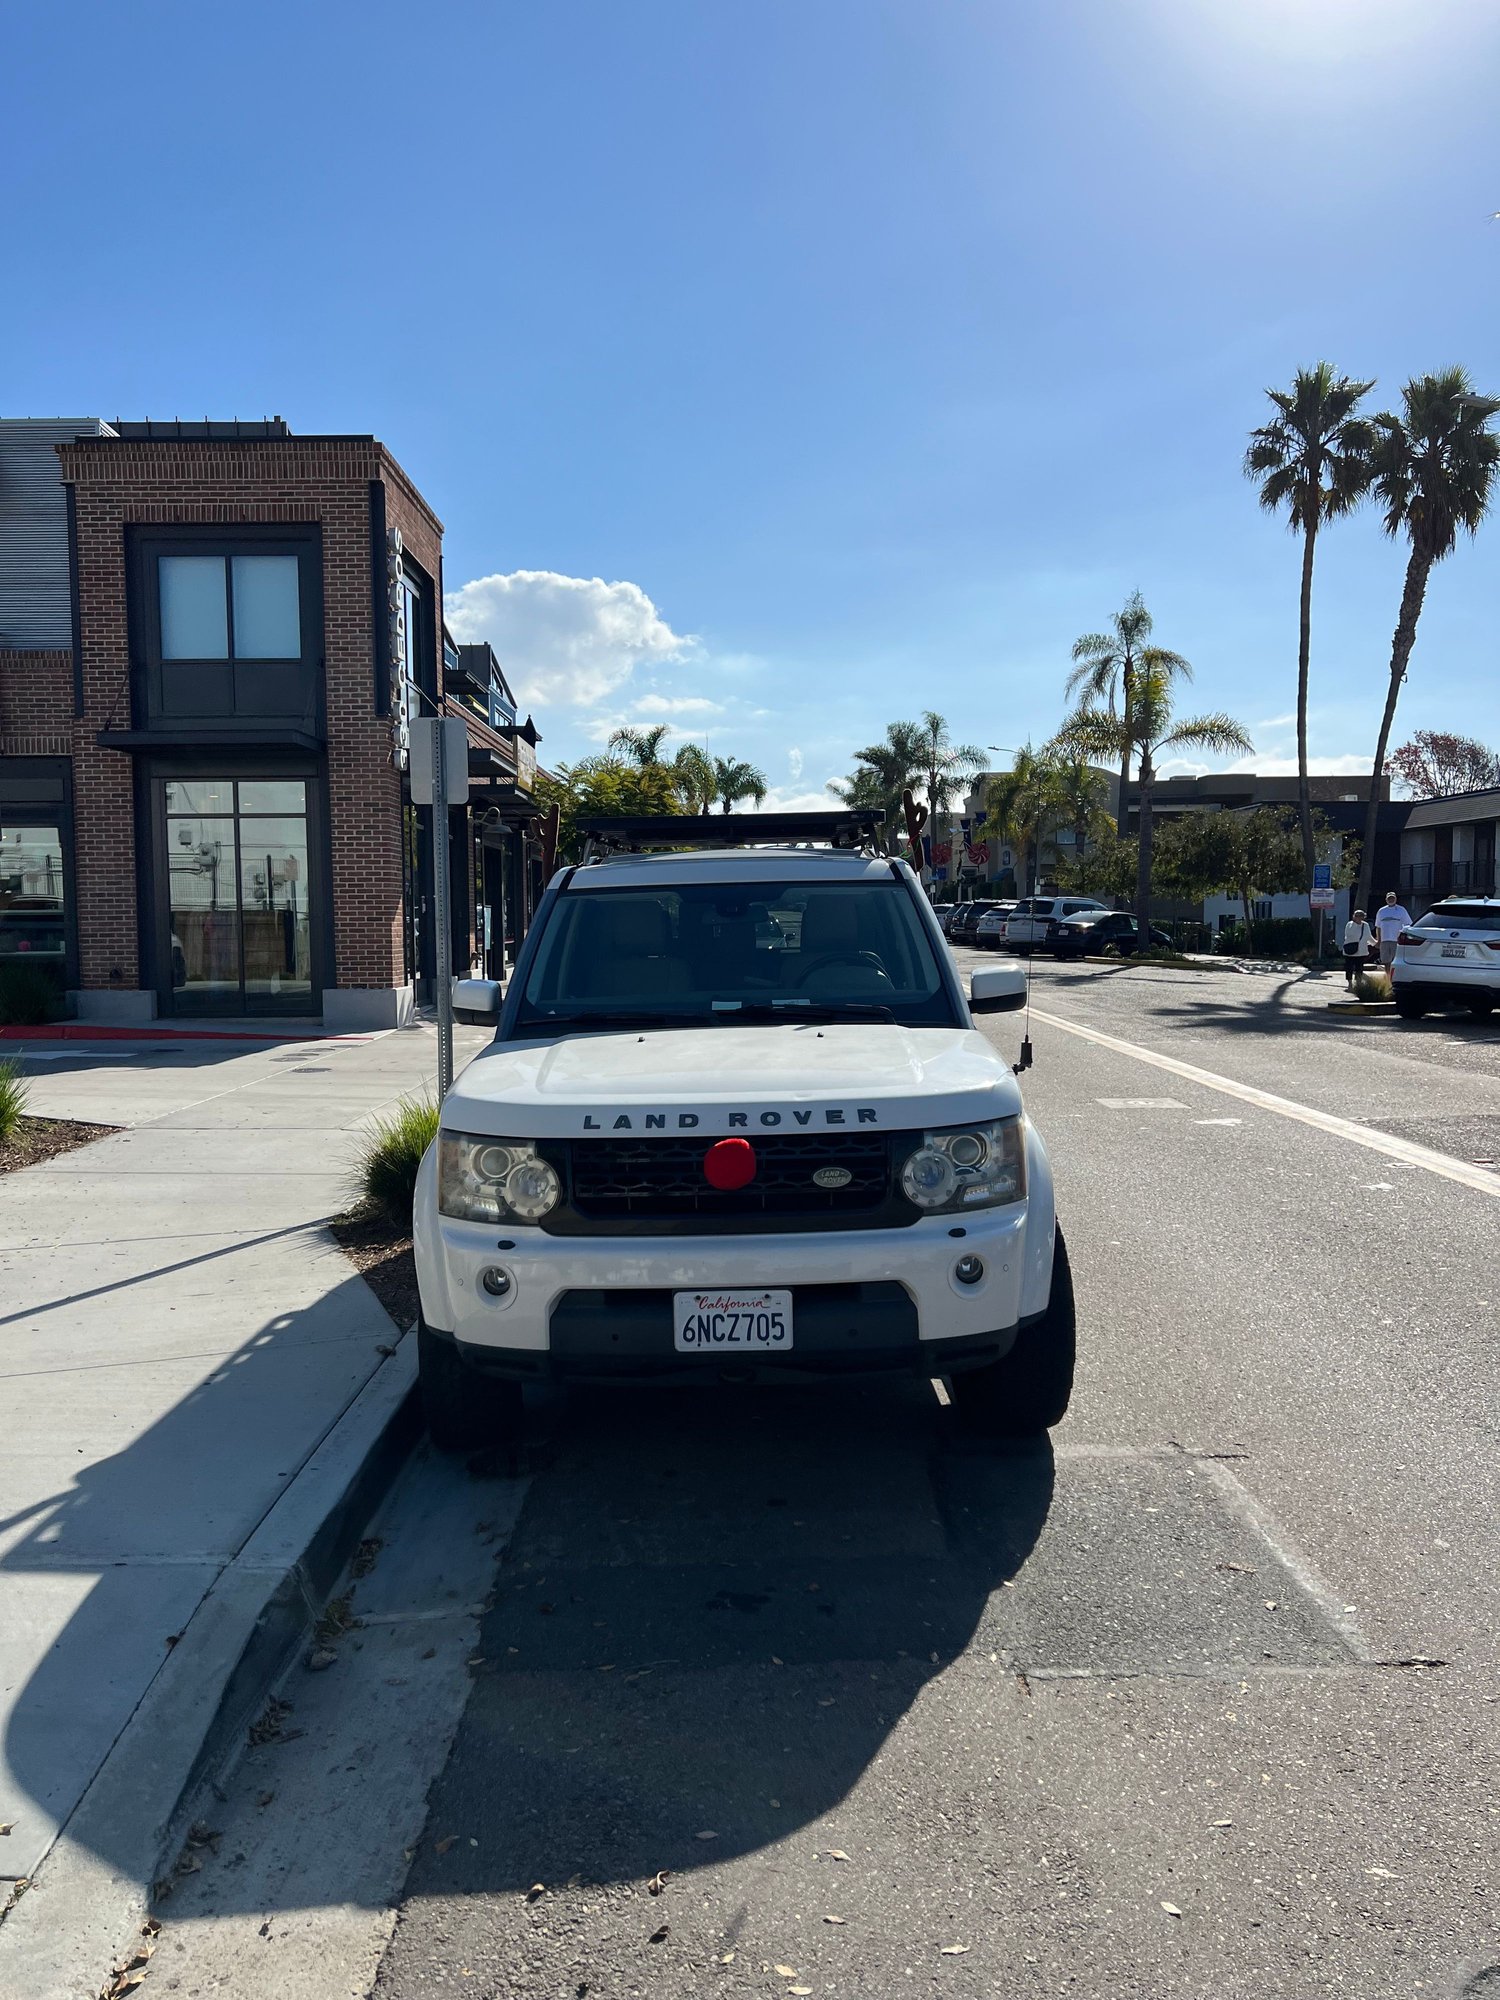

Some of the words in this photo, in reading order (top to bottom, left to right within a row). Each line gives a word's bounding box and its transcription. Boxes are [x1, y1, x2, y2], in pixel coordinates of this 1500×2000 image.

[394, 526, 406, 690] CEDROS
[583, 1114, 699, 1130] LAND
[729, 1108, 877, 1127] ROVER
[699, 1296, 770, 1313] California
[683, 1313, 785, 1343] 6NCZ705
